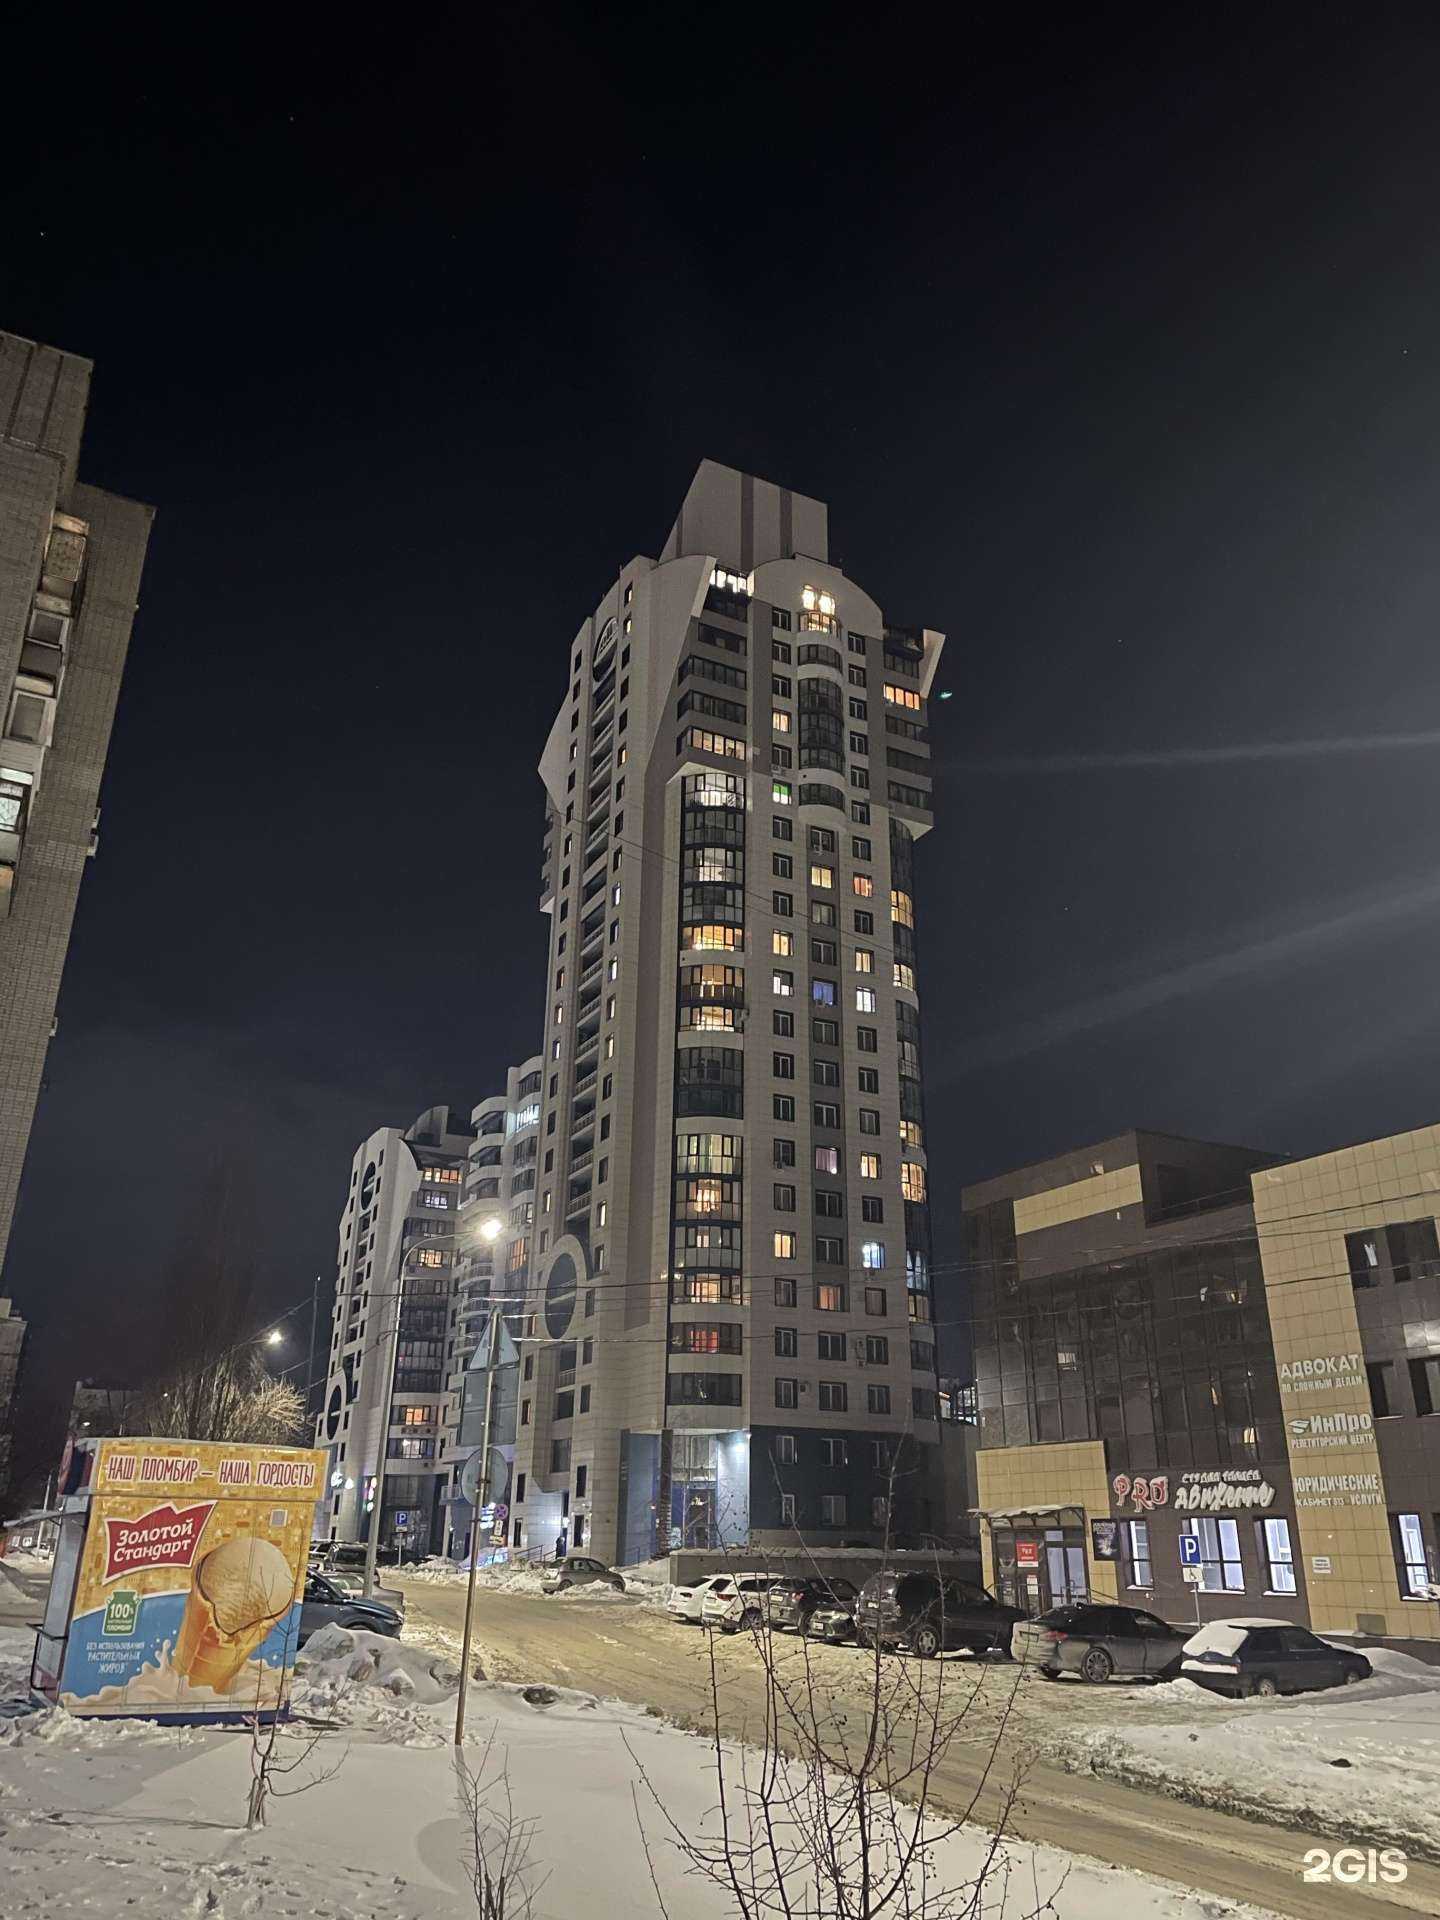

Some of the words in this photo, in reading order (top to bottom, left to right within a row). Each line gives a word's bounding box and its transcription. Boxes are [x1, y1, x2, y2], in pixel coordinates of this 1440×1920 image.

[1281, 1354, 1359, 1379] АДВОКАТ
[1335, 1376, 1362, 1388] ДЕЛАМ
[1310, 1413, 1372, 1433] ИнПро
[1351, 1434, 1374, 1445] ЦЕНТР
[108, 1457, 135, 1480] НАШ
[141, 1458, 198, 1482] ПЛОМБИР
[219, 1461, 249, 1484] НАША
[257, 1463, 314, 1486] ГОРДОСТЬ!
[1295, 1474, 1379, 1494] ЮРИДИЧЕСКИЕ
[1350, 1493, 1382, 1505] УСЛУГИ
[399, 1513, 407, 1523] P
[116, 1518, 194, 1547] Золотой
[114, 1539, 191, 1562] Стандарт
[1185, 1538, 1197, 1562] P
